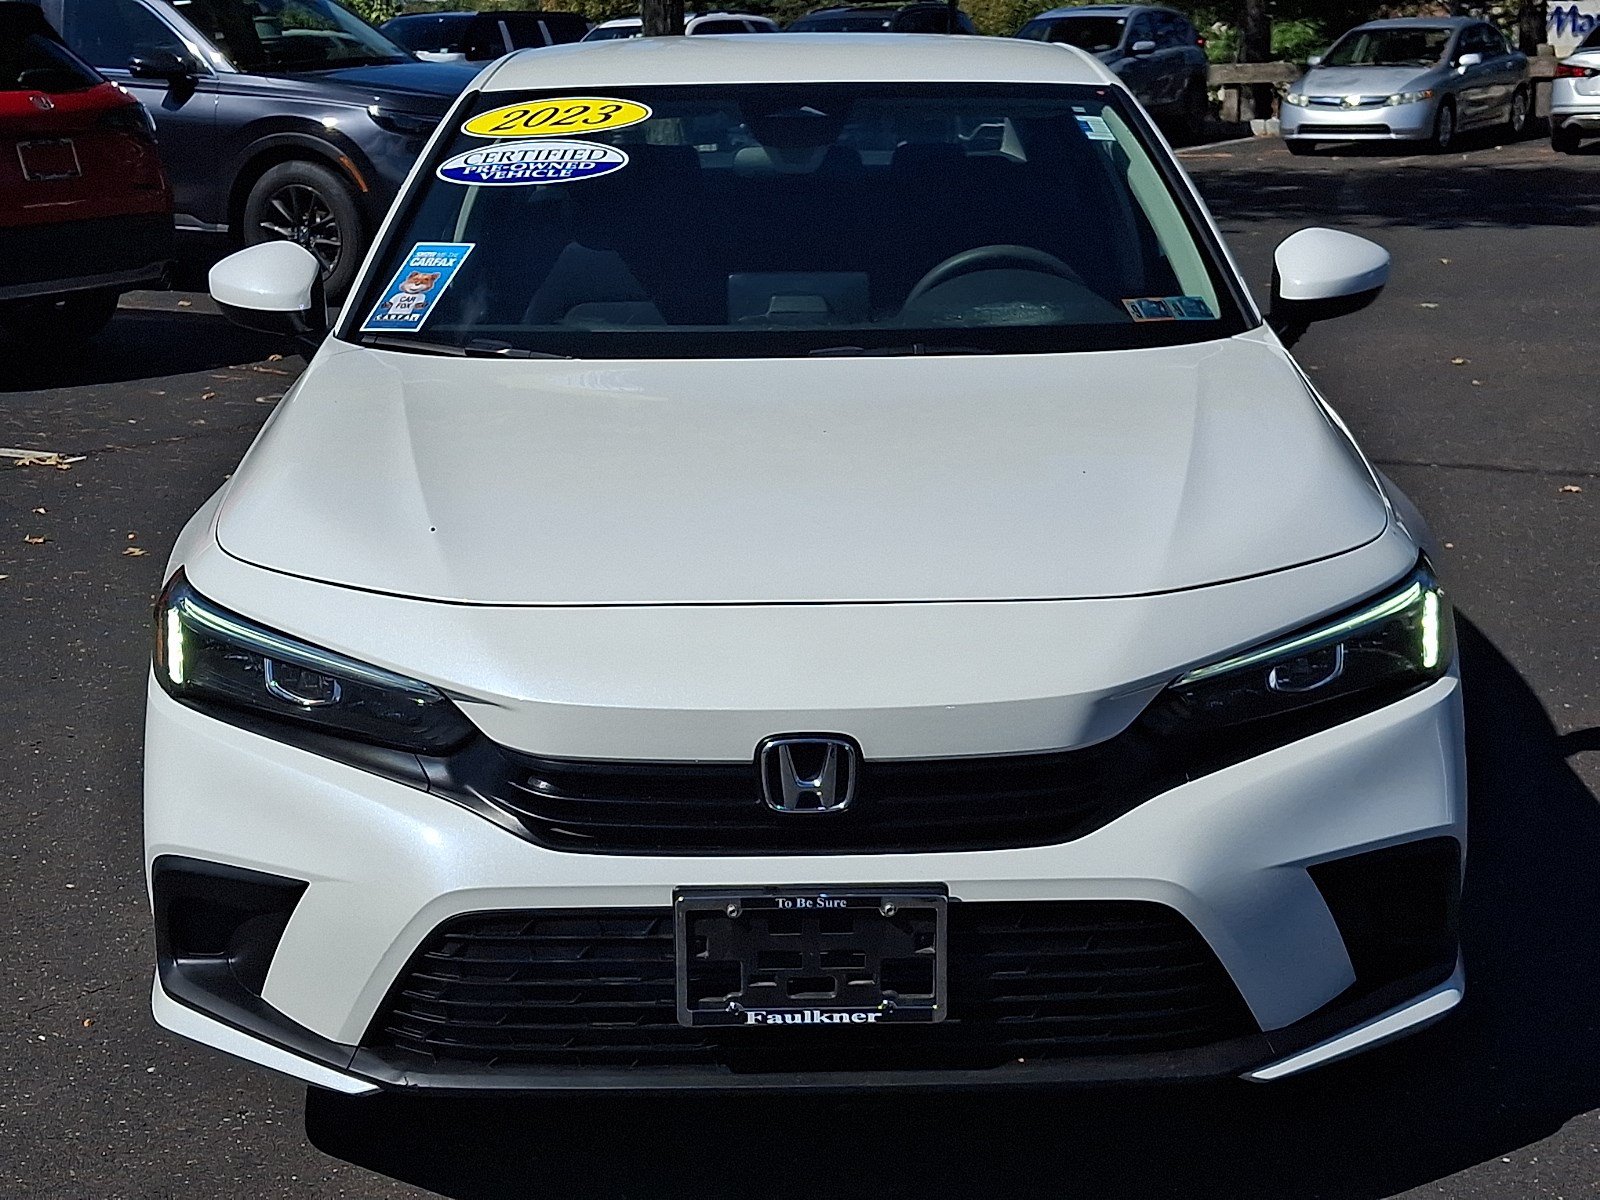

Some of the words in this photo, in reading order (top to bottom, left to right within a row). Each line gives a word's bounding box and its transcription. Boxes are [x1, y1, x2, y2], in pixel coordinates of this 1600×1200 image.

[489, 104, 623, 132] 2023
[463, 149, 608, 166] CERTIFIED
[462, 161, 596, 174] PRE-OWNED
[480, 169, 573, 180] VEHICLE
[409, 257, 457, 267] CARFAX
[775, 898, 793, 909] To
[796, 898, 813, 908] Be
[816, 897, 847, 908] Sure
[745, 1010, 882, 1024] Faulkner
